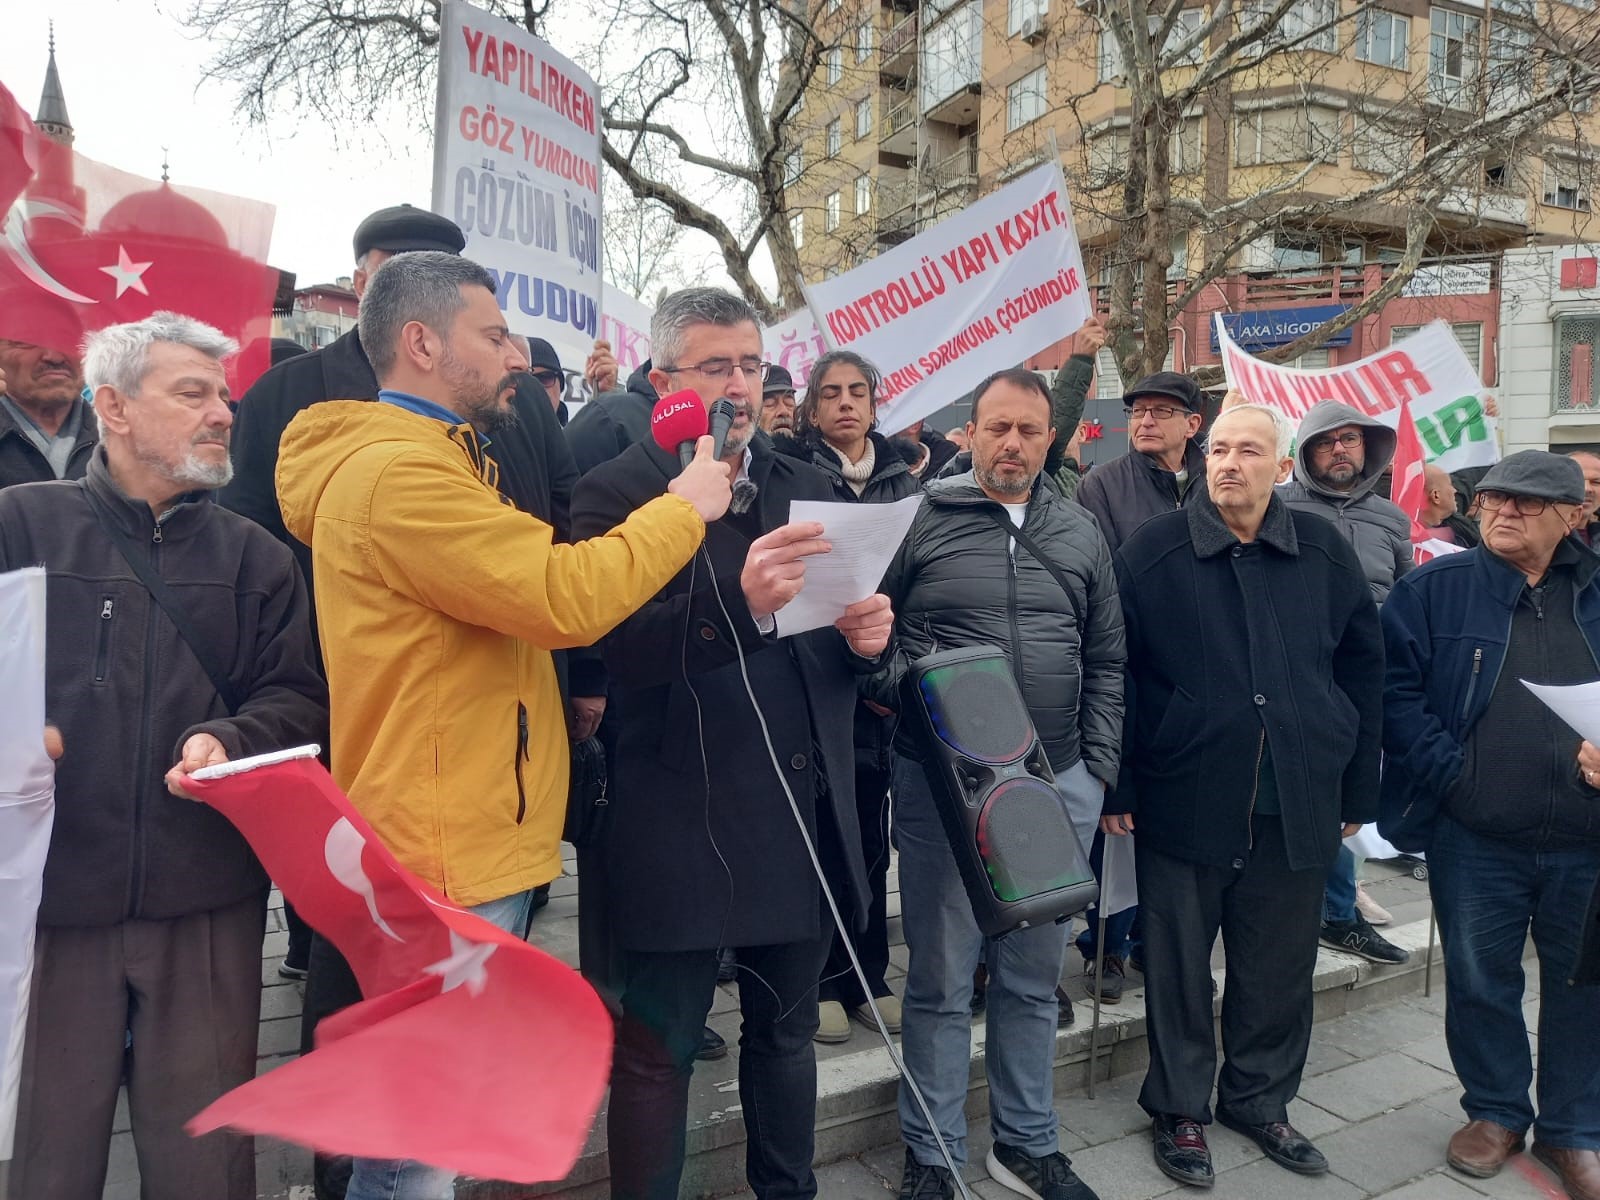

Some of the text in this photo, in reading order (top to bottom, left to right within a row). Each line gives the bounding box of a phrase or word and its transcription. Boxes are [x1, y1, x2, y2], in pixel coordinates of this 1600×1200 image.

[462, 25, 596, 136] YAPILIRKEN
[459, 103, 597, 195] GÖZ YUMDUN
[454, 157, 597, 276] ÇÖZÜM İÇİN
[485, 267, 597, 340] YUDUN
[825, 191, 1067, 347] KONTROLLÜ YAPI KAYIT,
[875, 267, 1080, 407] LARIN SORUNUNA ÇÖZÜMDÜR
[1241, 324, 1272, 338] AXA
[653, 400, 695, 424] ULUSAL
[1342, 931, 1369, 951] N
